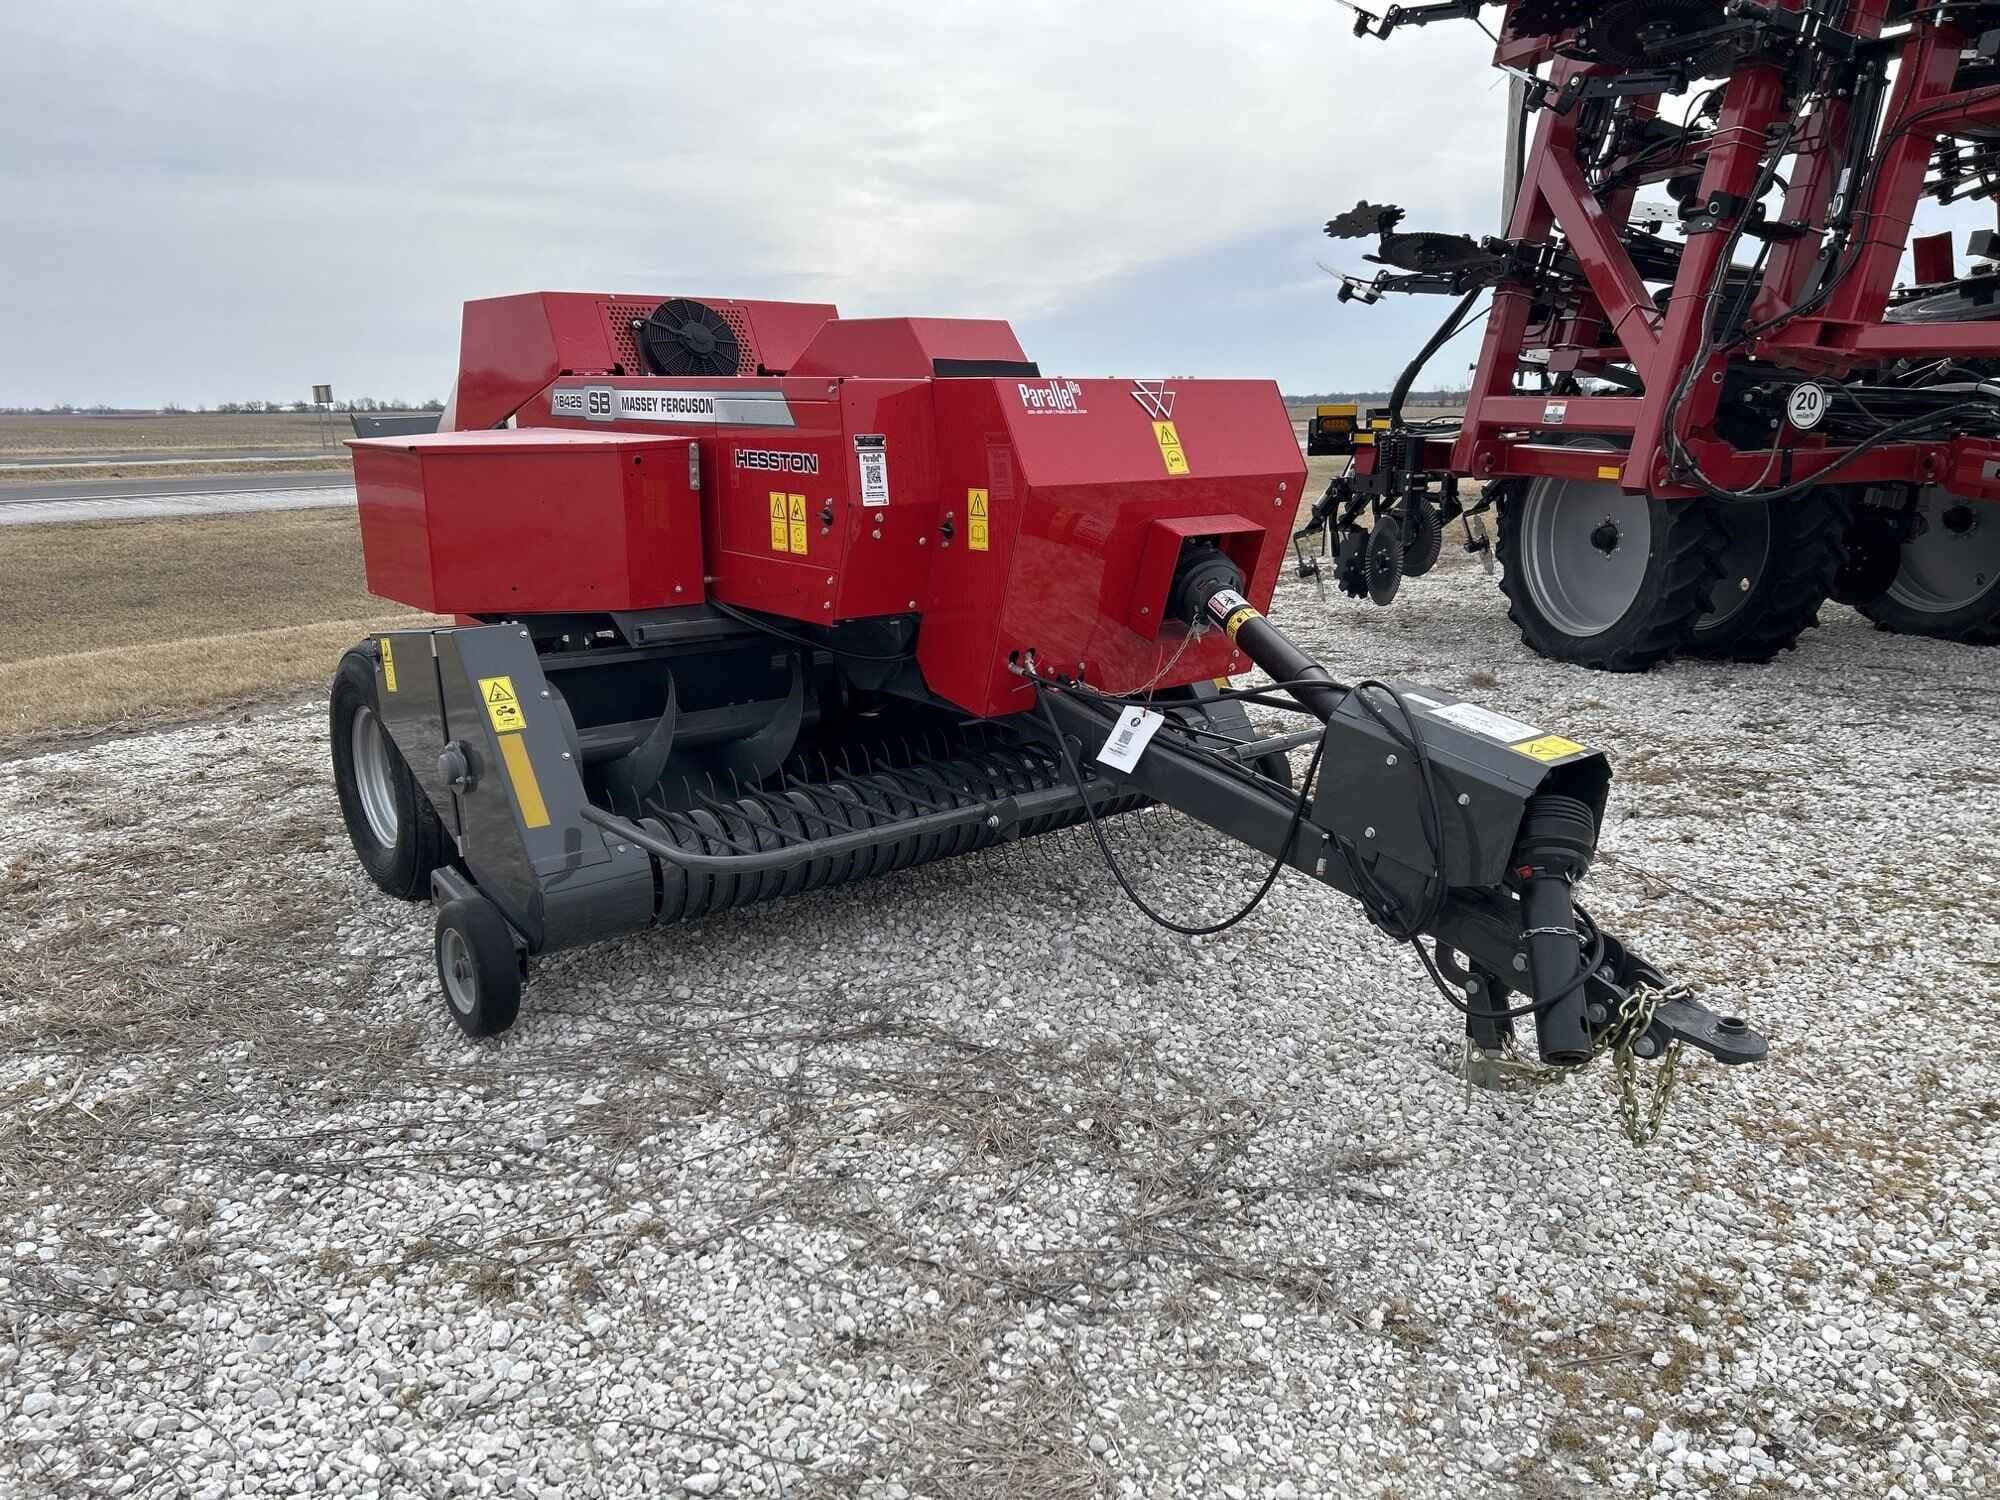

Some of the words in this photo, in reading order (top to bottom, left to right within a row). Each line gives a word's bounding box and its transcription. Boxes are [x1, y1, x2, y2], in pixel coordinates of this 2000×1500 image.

[588, 391, 611, 414] SB
[621, 396, 658, 413] MASSEY
[661, 397, 714, 414] FERGUSON
[1795, 391, 1818, 411] 20
[735, 449, 818, 473] HESSTON
